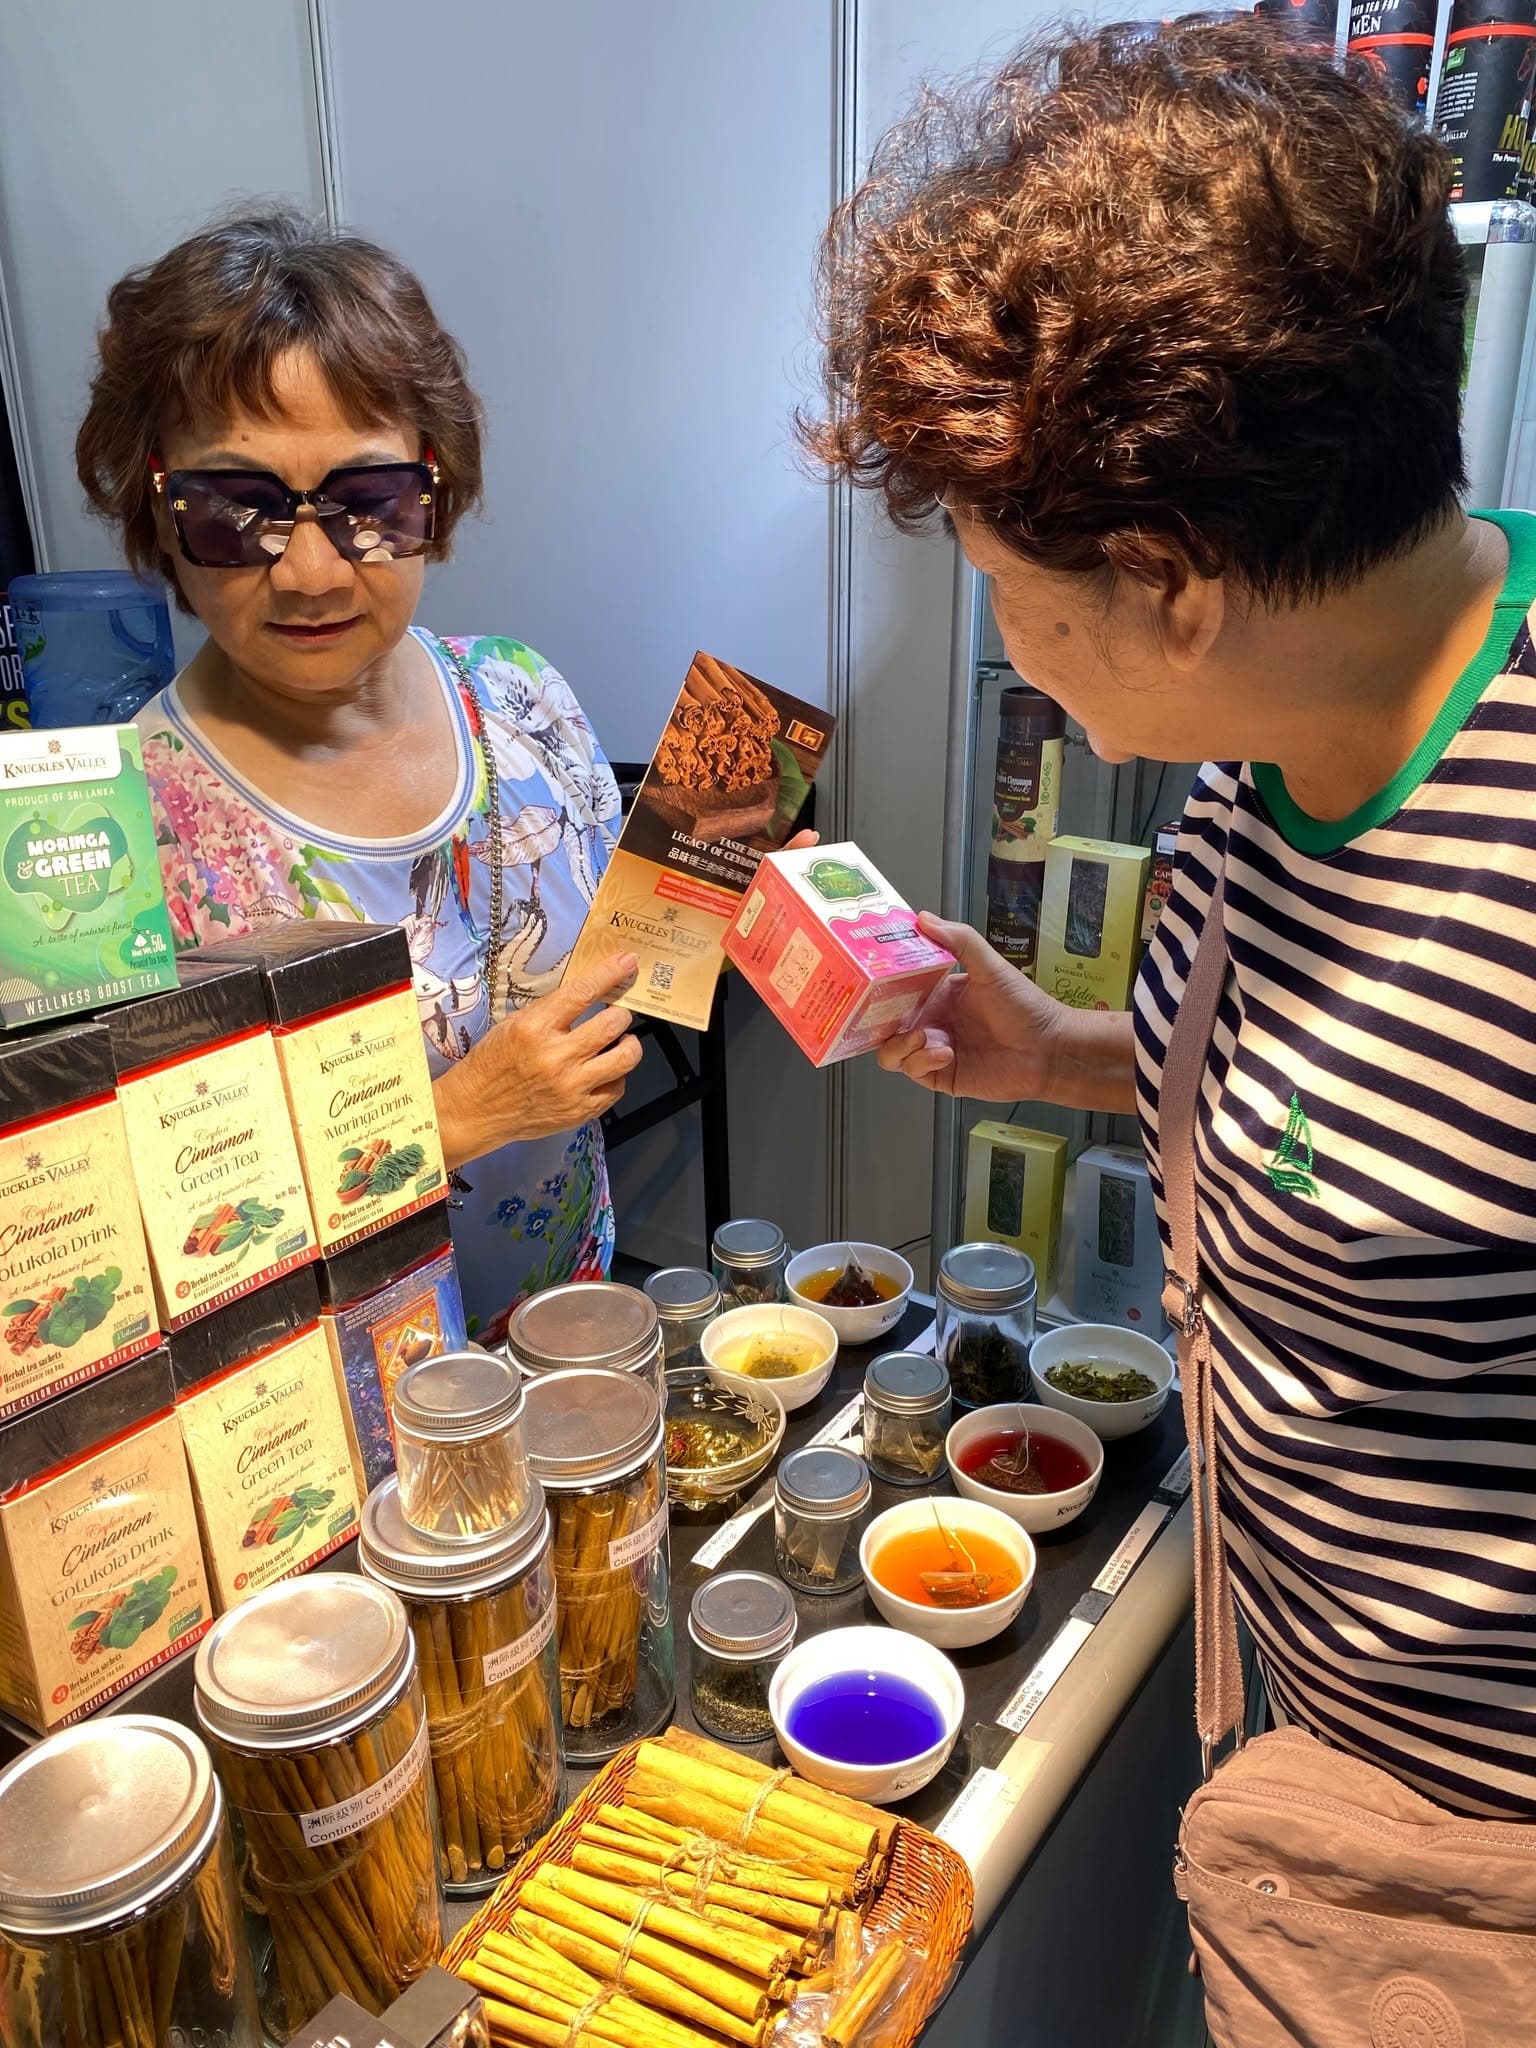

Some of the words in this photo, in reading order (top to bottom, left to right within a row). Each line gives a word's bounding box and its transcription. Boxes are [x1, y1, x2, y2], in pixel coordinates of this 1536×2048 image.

[1352, 15, 1382, 35] MEN
[4, 761, 64, 779] KNUCKLES
[66, 757, 107, 771] VALLEY
[5, 794, 48, 807] PRODUCT
[53, 792, 63, 802] OF
[67, 790, 82, 800] SRI
[86, 787, 115, 798] LANKA
[17, 860, 33, 879] &
[35, 848, 112, 878] GREEN
[27, 831, 110, 857] MORINGA
[672, 830, 710, 851] LEGACY
[710, 846, 725, 857] OF
[720, 836, 746, 853] TASTE
[58, 873, 101, 897] TEA
[609, 910, 670, 937] KNUCKLES
[24, 988, 91, 1016] WELLNESS
[97, 978, 134, 999] BOOST
[140, 973, 160, 989] TEA
[320, 1048, 365, 1075] KNUCKLES
[364, 1036, 396, 1056] VALLEY
[159, 1100, 213, 1130] KNUCKLES
[213, 1085, 249, 1107] VALLEY
[329, 1074, 401, 1119] Cinnamon
[324, 1108, 379, 1141] Moringa
[380, 1093, 414, 1116] Drink
[175, 1128, 254, 1175] Cinnamon
[180, 1163, 230, 1193] Green
[231, 1150, 259, 1171] Tea
[0, 1174, 46, 1199] UCKLES
[46, 1157, 91, 1182] VALLEY
[0, 1203, 95, 1256] Cinnamon
[330, 1232, 360, 1253] CEYLON
[0, 1243, 68, 1281] otukola
[71, 1224, 119, 1252] Drink
[179, 1301, 211, 1324] CEYLON
[214, 1279, 255, 1306] CINNAMON
[267, 1258, 293, 1276] GREEN
[296, 1249, 311, 1263] TEA
[191, 1274, 209, 1289] Herbal
[208, 1271, 218, 1281] tea
[0, 1403, 17, 1418] RUE
[20, 1388, 52, 1408] CEYLON
[55, 1365, 97, 1391] CINNAMON
[130, 1338, 150, 1354] KOLA
[3, 1366, 26, 1383] Herbal
[26, 1363, 38, 1375] tea
[38, 1351, 62, 1369] sachets
[222, 1398, 271, 1435] KNUCKLES
[270, 1378, 304, 1404] VALLEY
[237, 1419, 307, 1474] Cinnamon
[241, 1455, 286, 1491] Green
[286, 1438, 313, 1460] Tea
[108, 1470, 150, 1498] VALLEY
[62, 1512, 152, 1577] Cinnamon
[51, 1553, 128, 1607] Gotukola
[130, 1527, 175, 1560] Drink
[248, 1564, 265, 1580] Herbal
[265, 1558, 274, 1569] tea
[62, 1711, 83, 1727] TRUE
[84, 1687, 113, 1712] CEYLON
[116, 1661, 154, 1690] CINNAMON
[186, 1628, 204, 1644] KOLA
[69, 1673, 90, 1691] Herbal
[90, 1668, 100, 1679] tea
[100, 1653, 122, 1672] sachets
[488, 1642, 540, 1682] Continental
[999, 1691, 1026, 1725] Cinnamon
[1031, 1668, 1043, 1681] Tea
[307, 1800, 363, 1830] 洲际级别
[310, 1808, 380, 1843] Continental
